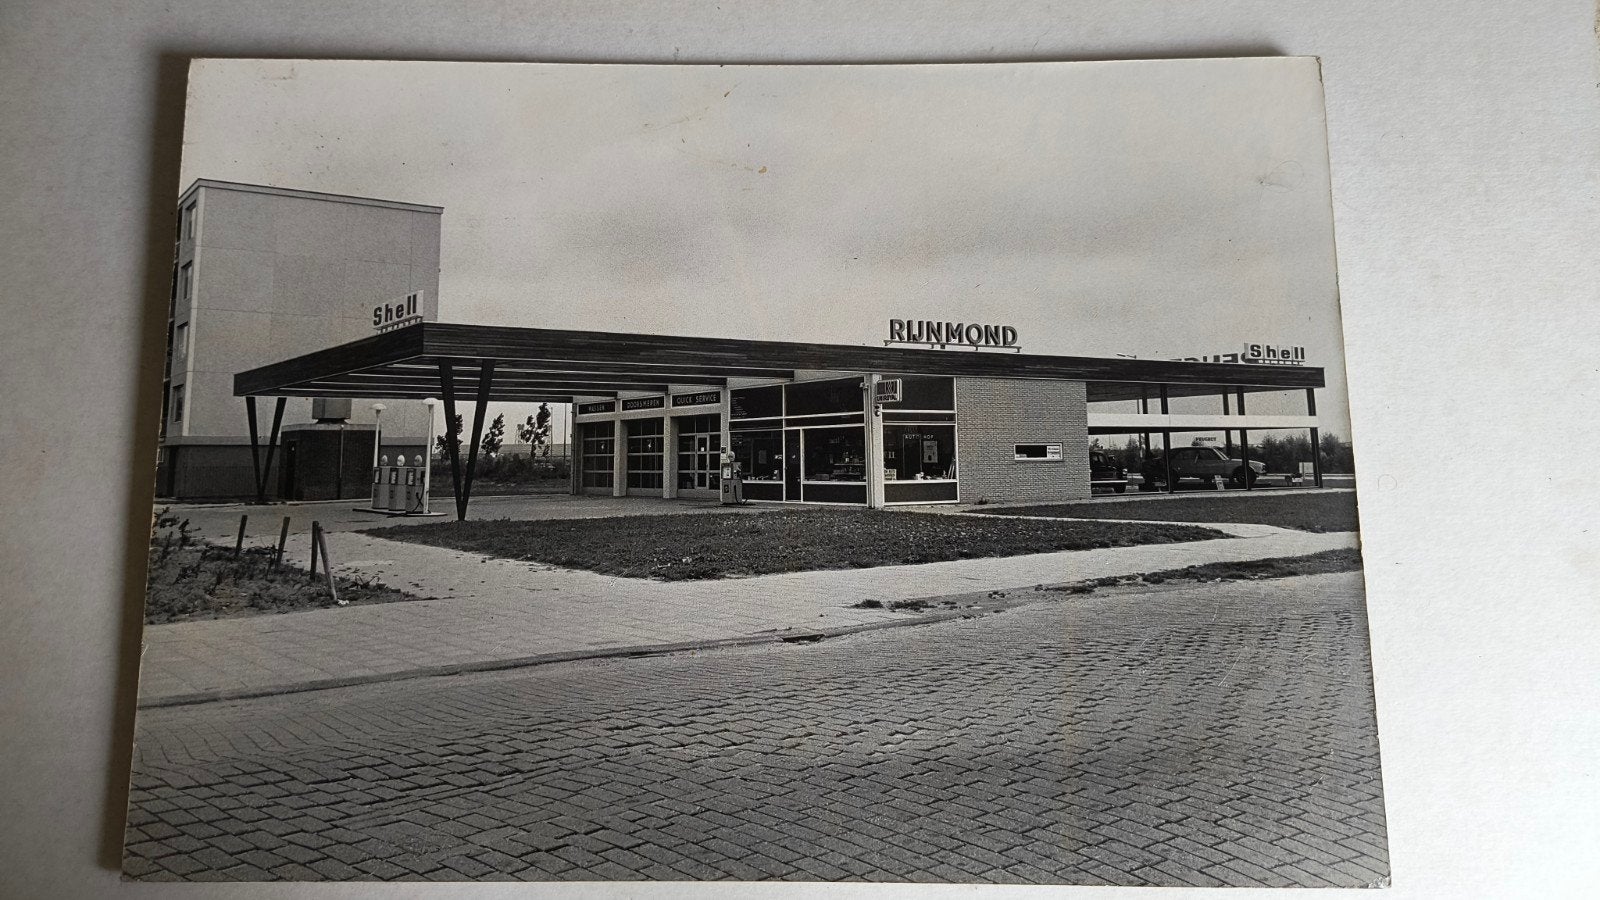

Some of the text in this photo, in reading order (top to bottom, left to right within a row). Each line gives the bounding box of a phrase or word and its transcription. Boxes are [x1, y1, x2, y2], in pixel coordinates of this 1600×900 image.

[373, 294, 417, 326] Shell
[889, 318, 1018, 346] RIJNMOND
[1250, 344, 1305, 360] Shell
[676, 393, 717, 405] QUICK SERVICE
